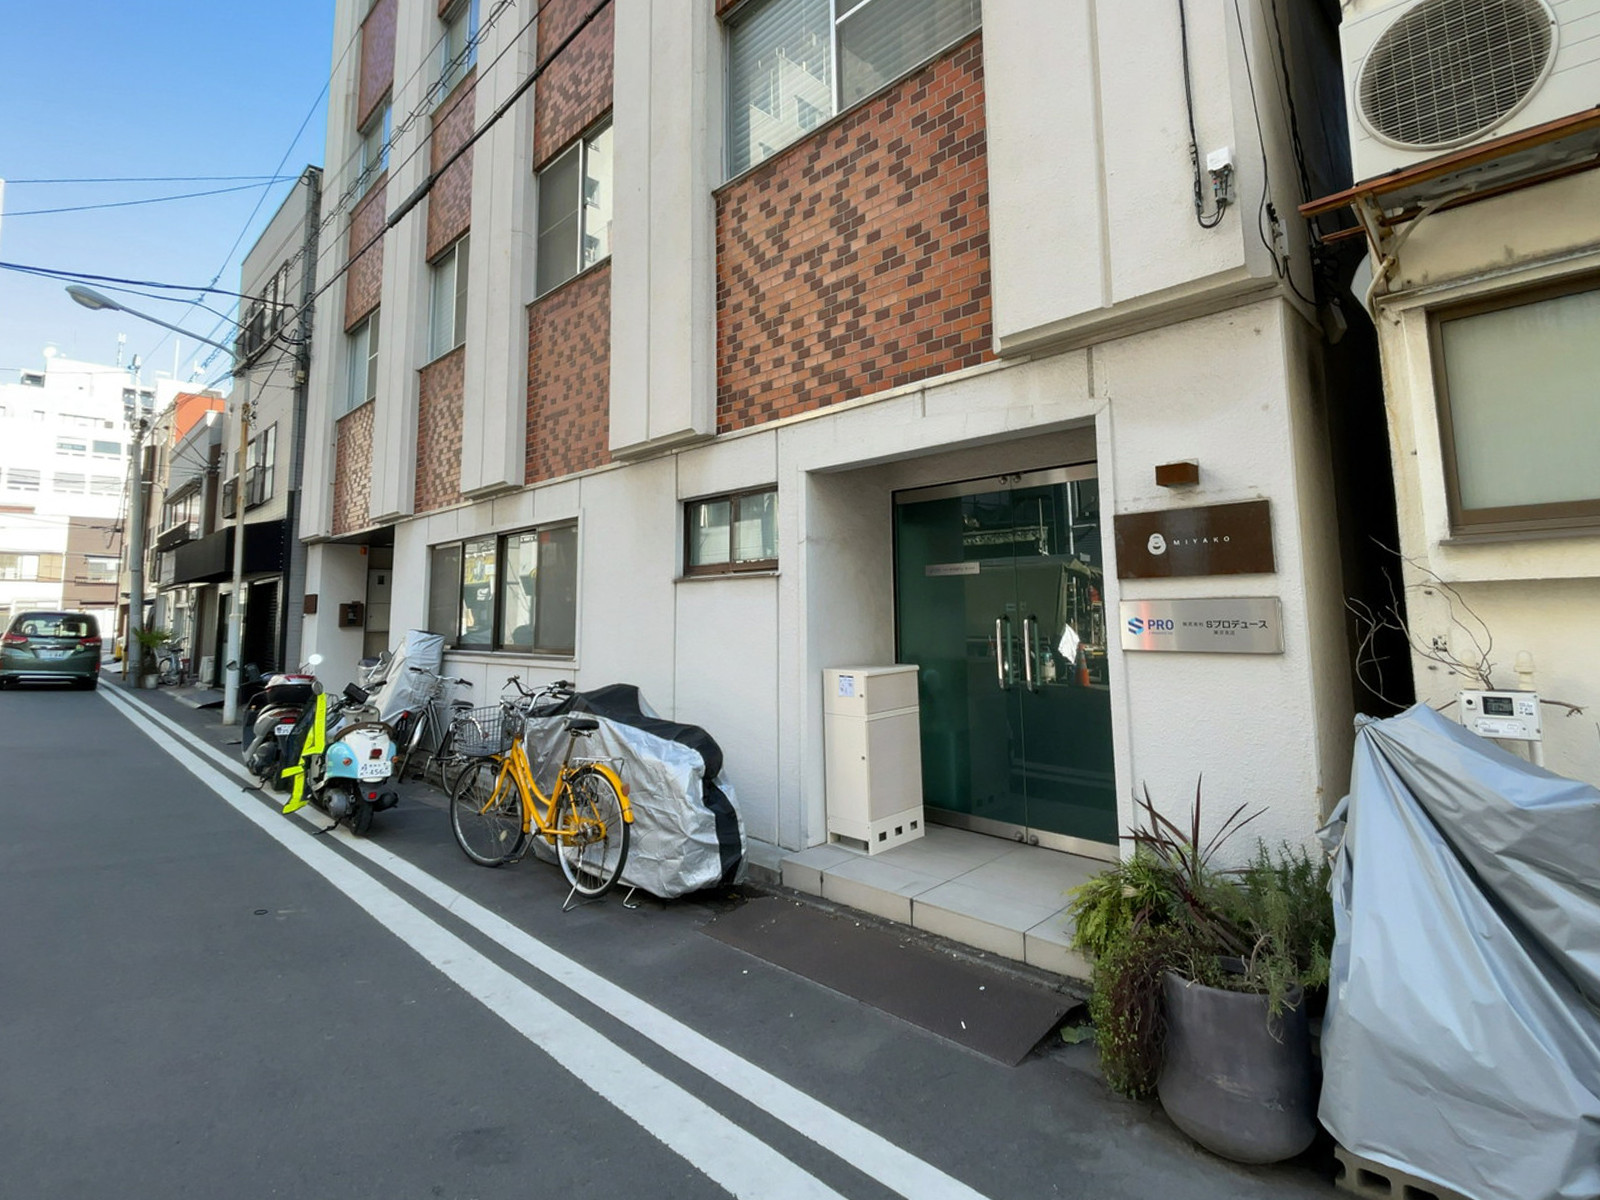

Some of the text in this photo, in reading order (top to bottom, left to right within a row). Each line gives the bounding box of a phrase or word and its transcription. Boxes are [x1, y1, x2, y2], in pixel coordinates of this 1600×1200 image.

[1173, 535, 1230, 546] MIYAKO
[1147, 619, 1174, 630] PRO
[1205, 619, 1269, 629] Sプロデュース
